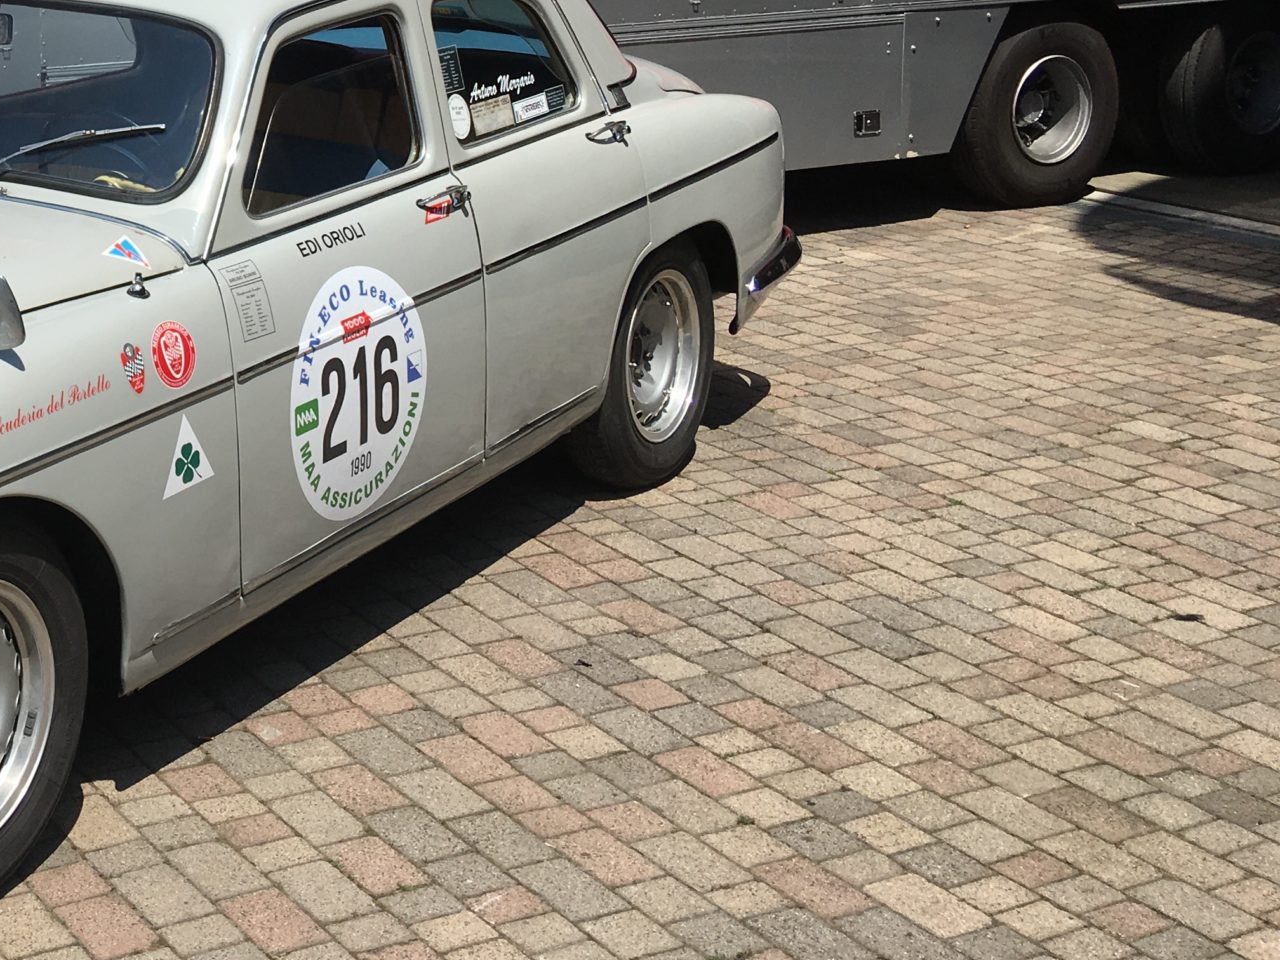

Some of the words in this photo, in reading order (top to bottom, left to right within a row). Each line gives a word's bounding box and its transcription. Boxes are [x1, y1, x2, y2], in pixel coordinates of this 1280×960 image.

[296, 240, 322, 257] EDI
[320, 222, 366, 248] ORIOLI
[299, 284, 351, 387] FIN-ECO
[358, 280, 415, 343] Leasing
[344, 315, 366, 330] 1000
[46, 394, 65, 416] del
[67, 373, 111, 405] Portello
[320, 334, 400, 465] 216
[300, 440, 321, 492] MAA
[321, 391, 419, 509] ASSICURAZIONI
[350, 450, 372, 478] 1990
